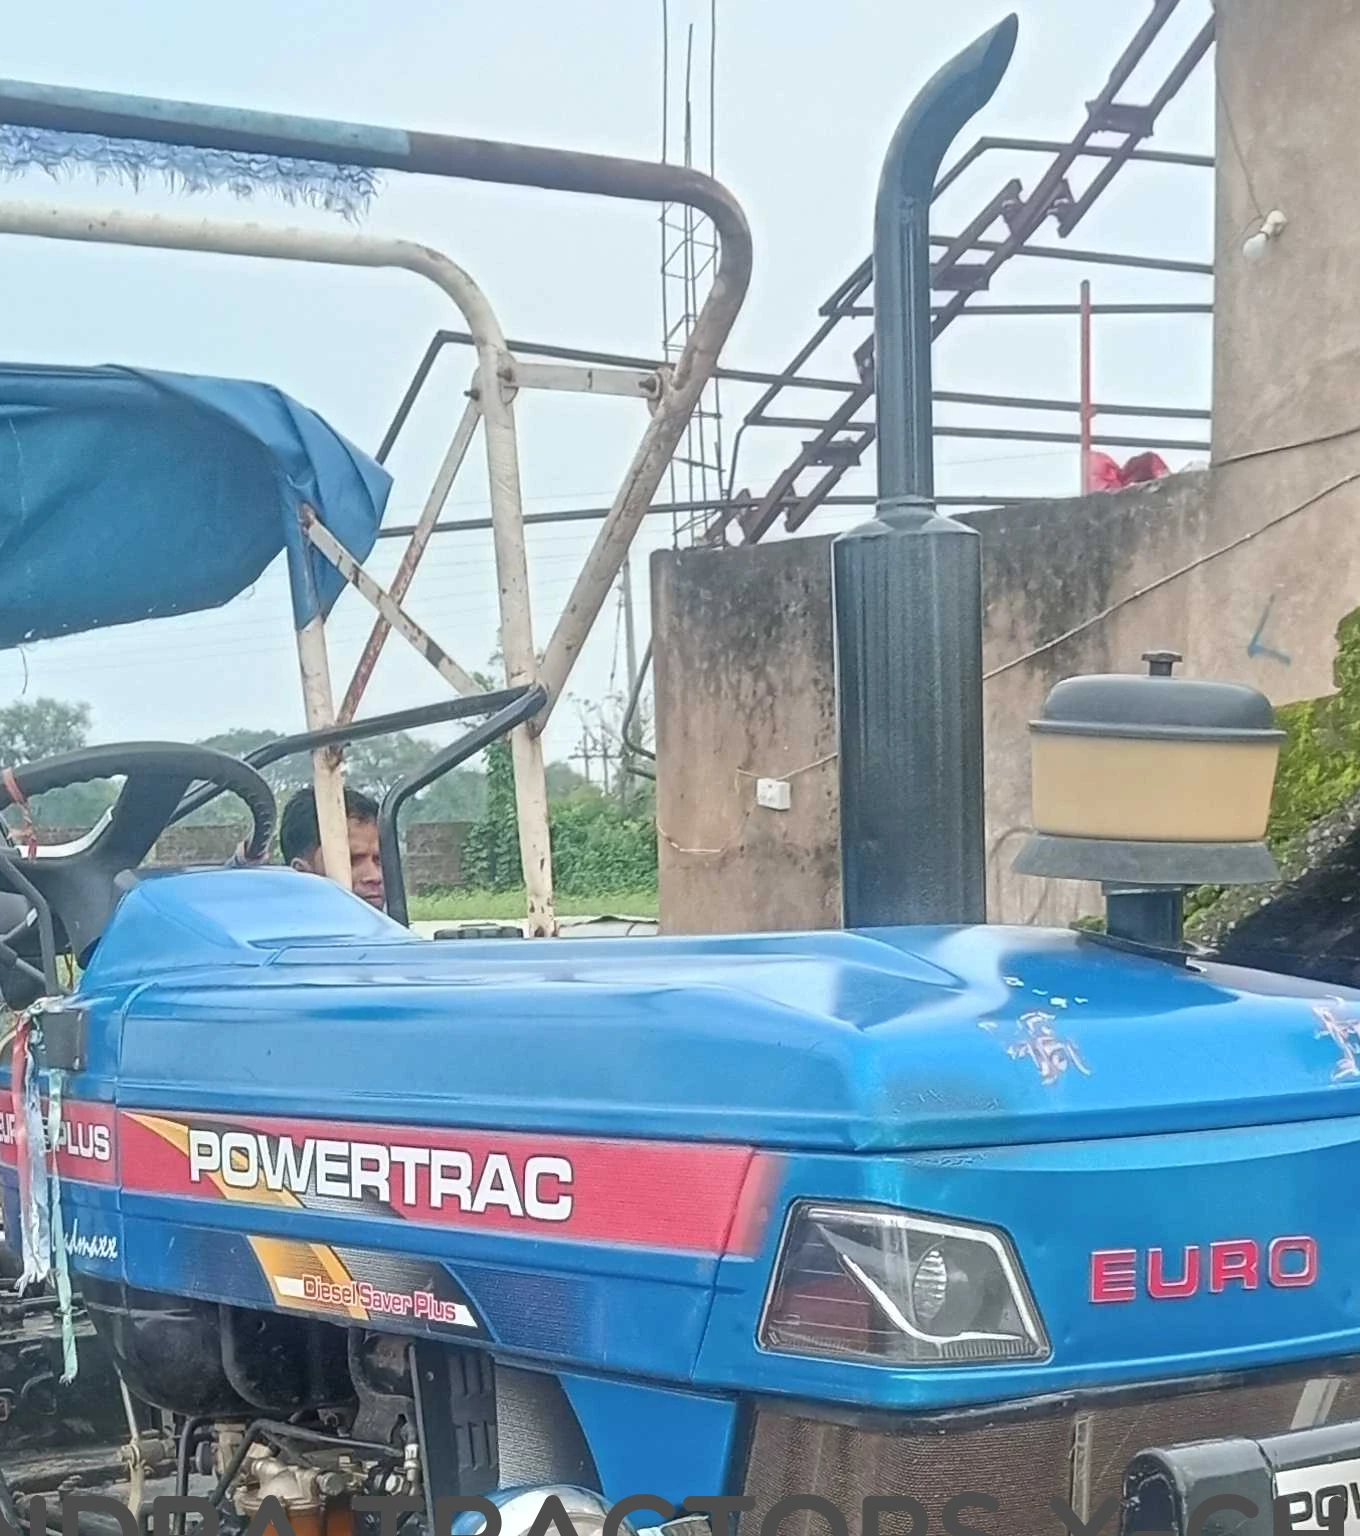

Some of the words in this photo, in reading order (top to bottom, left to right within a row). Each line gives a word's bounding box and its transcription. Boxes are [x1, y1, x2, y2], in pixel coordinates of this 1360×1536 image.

[189, 1129, 574, 1221] POWERTRAC
[302, 1274, 357, 1306] Diesel
[358, 1282, 412, 1315] Saver
[414, 1291, 457, 1321] Plus
[1090, 1235, 1318, 1303] EURO
